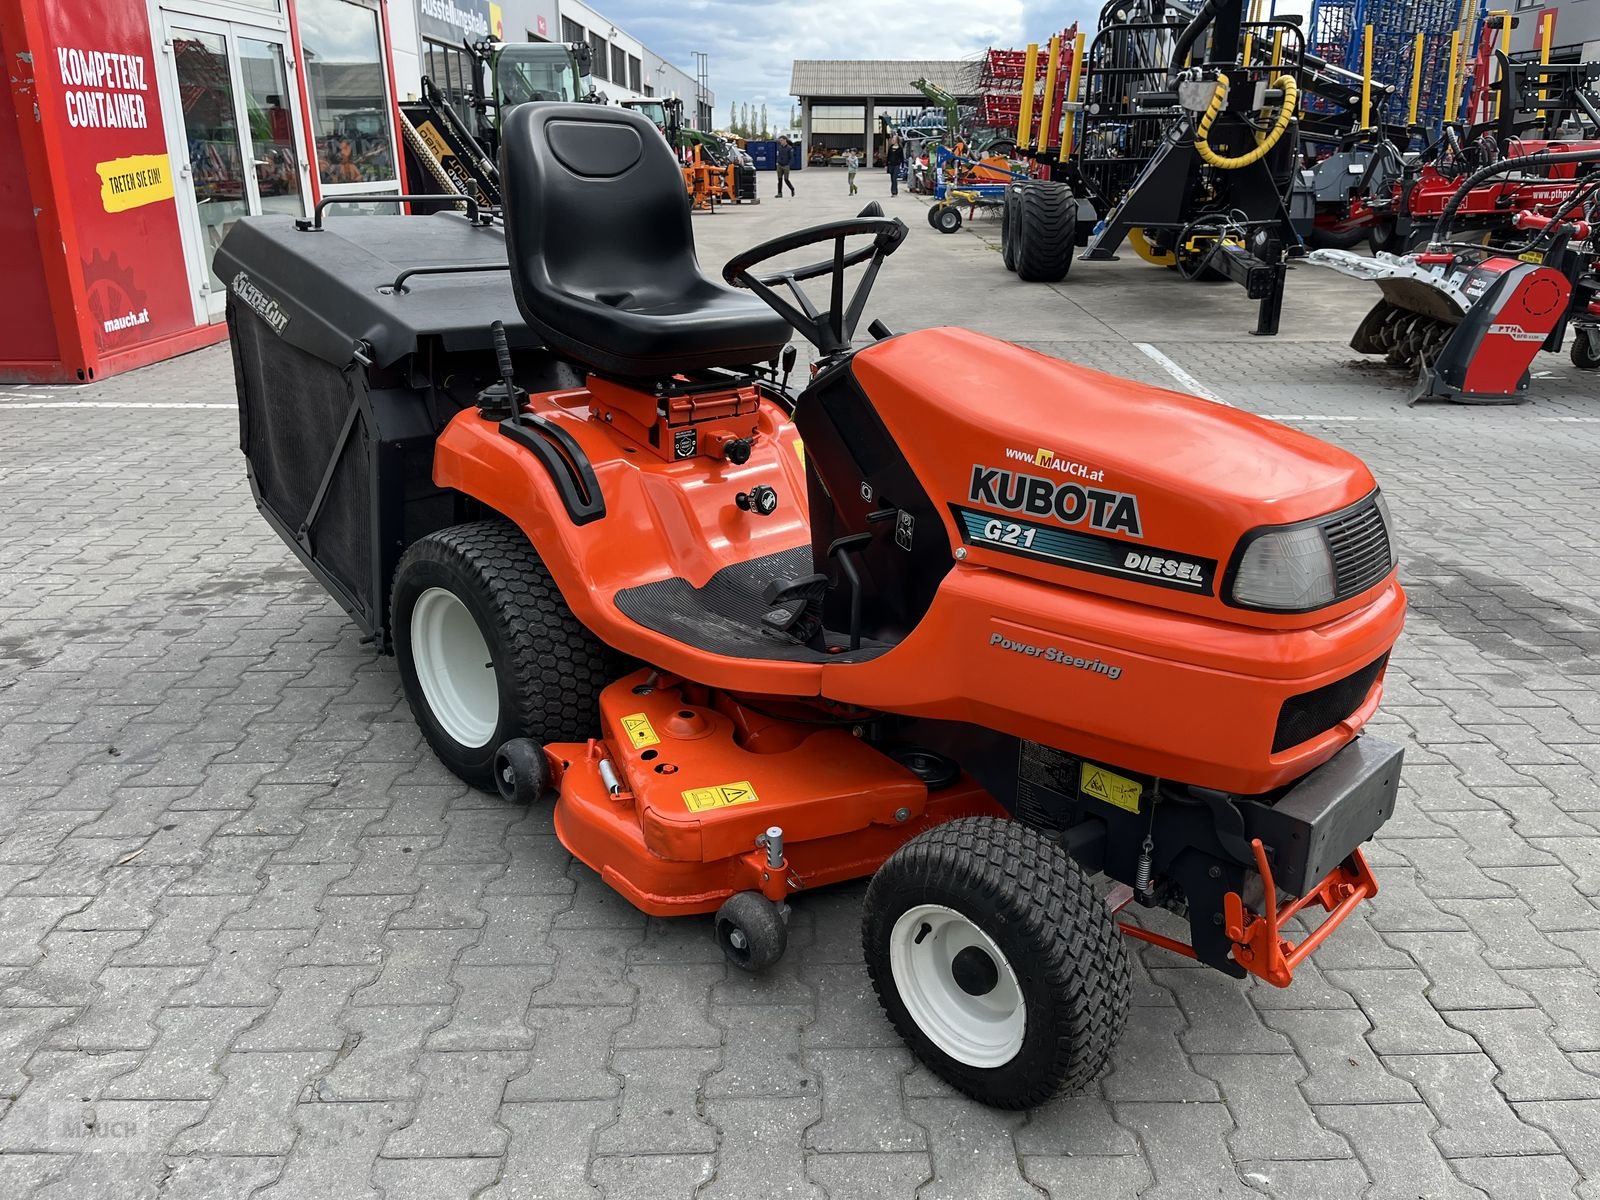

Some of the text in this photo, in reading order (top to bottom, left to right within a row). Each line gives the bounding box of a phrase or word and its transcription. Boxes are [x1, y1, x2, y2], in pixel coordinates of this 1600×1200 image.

[57, 46, 148, 91] KOMPETENZ
[65, 90, 148, 128] CONTAINER
[419, 129, 440, 156] 480
[108, 167, 162, 195] TRETEN SIE EIN!
[103, 308, 150, 333] mauch.at
[1006, 448, 1105, 482] www.MAUCH.at
[968, 464, 1144, 539] KUBOTA
[984, 519, 1037, 548] G21
[1124, 552, 1204, 582] DIESEL
